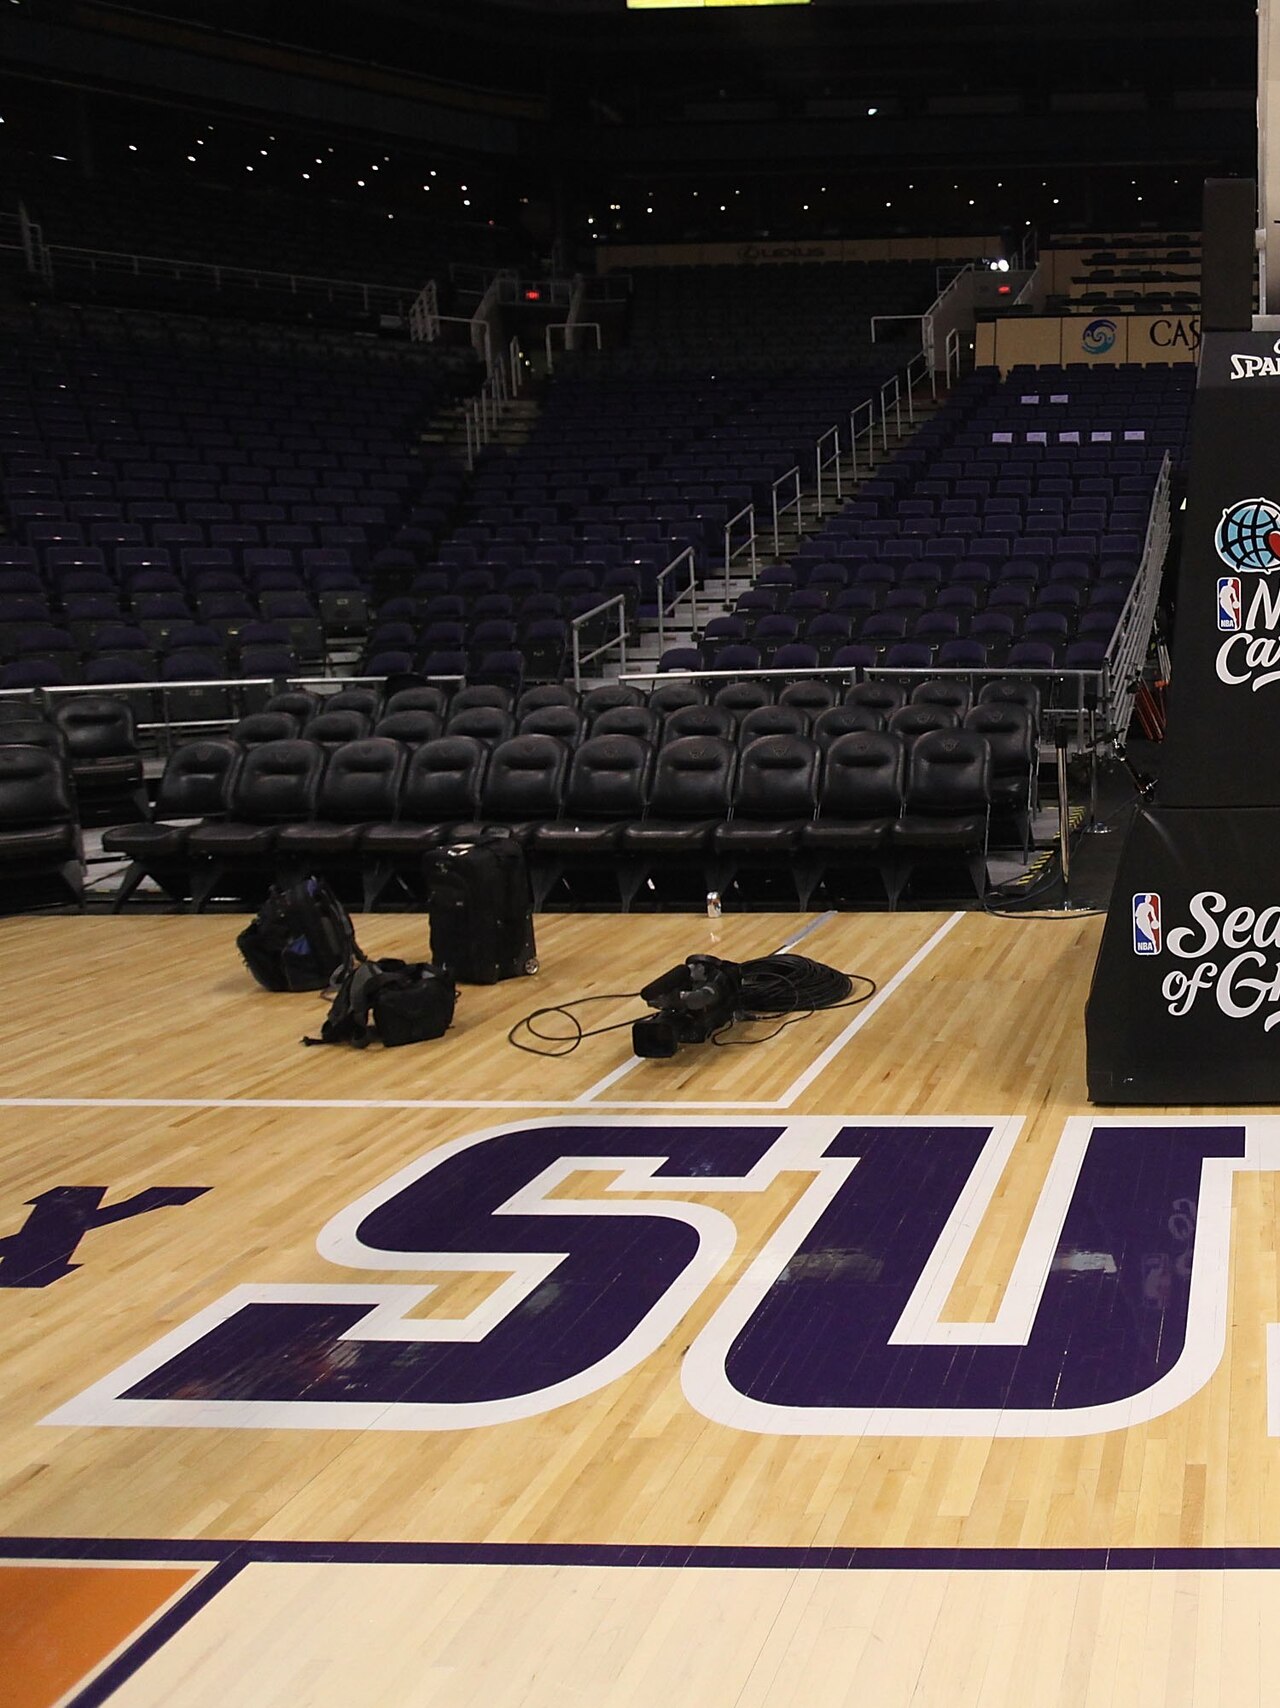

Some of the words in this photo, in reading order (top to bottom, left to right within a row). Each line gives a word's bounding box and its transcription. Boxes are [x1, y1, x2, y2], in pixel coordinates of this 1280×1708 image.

[1220, 619, 1235, 628] NBA
[1137, 941, 1153, 951] NBA
[1161, 961, 1219, 1017] of
